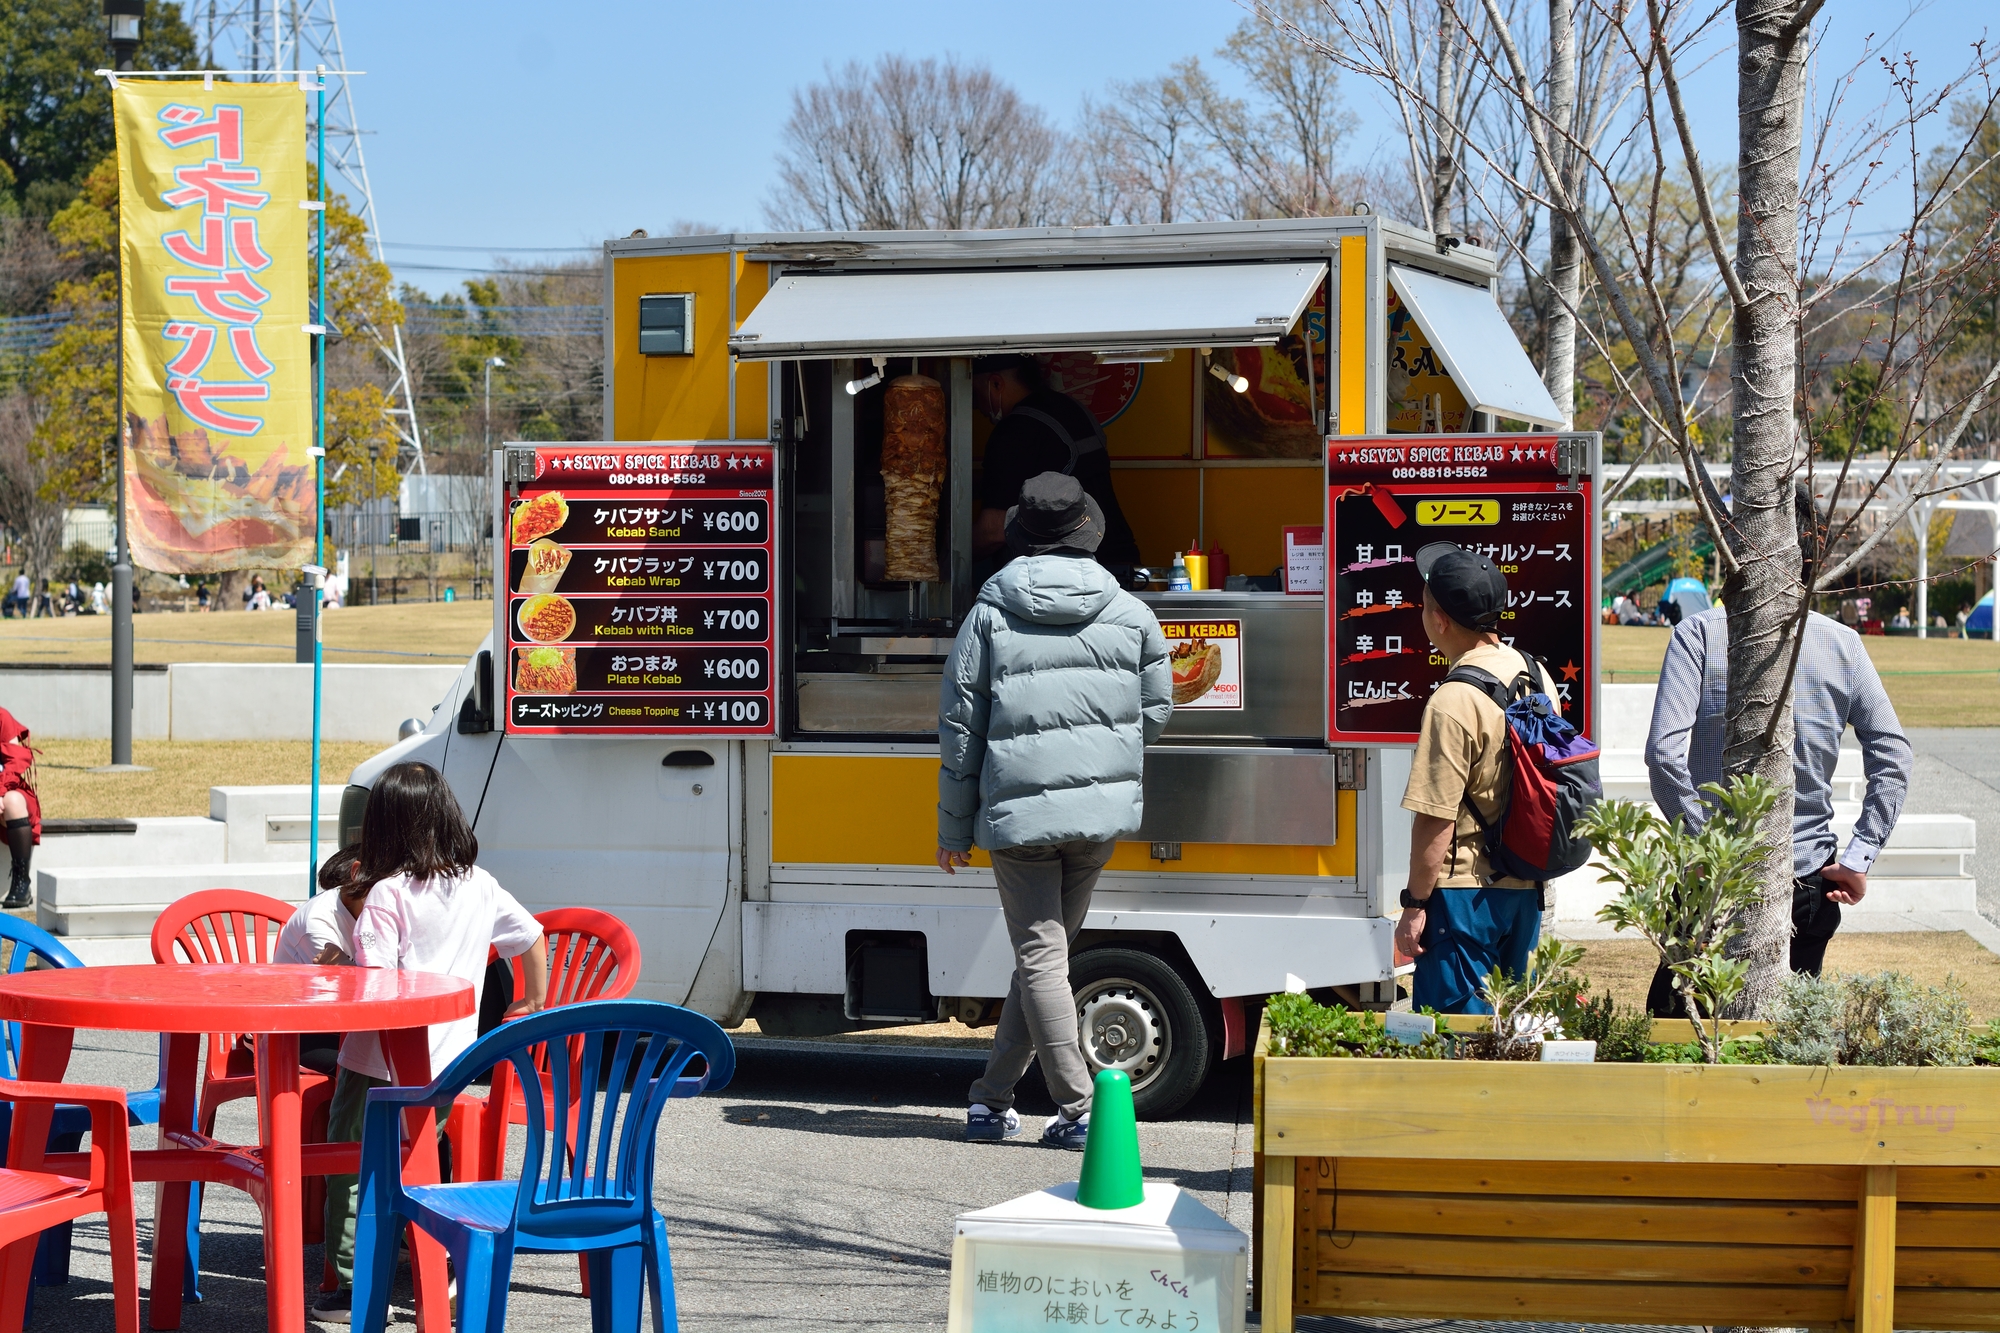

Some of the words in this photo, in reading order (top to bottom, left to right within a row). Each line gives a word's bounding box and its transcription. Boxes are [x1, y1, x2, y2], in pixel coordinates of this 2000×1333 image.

[573, 454, 621, 470] SEVEN
[625, 454, 666, 470] SPICE
[669, 453, 720, 470] KEBAB
[1360, 447, 1405, 464] SEVEN
[1409, 446, 1451, 463] SPICE
[1453, 445, 1504, 462] KEBAB
[1430, 504, 1486, 522] ソース
[1512, 502, 1574, 512] お好きなソースを
[593, 508, 695, 525] ケバブサンド
[702, 511, 760, 532] ¥600
[1512, 512, 1566, 521] お選びください
[606, 527, 646, 538] Kebab
[649, 527, 681, 538] Sand
[593, 557, 695, 574] ケバブラップ
[702, 560, 760, 581] ¥700
[606, 576, 646, 587] Kebab
[649, 576, 681, 588] Wrap
[610, 606, 678, 623] ケバブ丼
[703, 610, 760, 630] ¥700
[594, 625, 634, 636] Kebab
[636, 625, 664, 636] with
[666, 625, 694, 636] Rice
[1190, 624, 1237, 637] KEBAB
[611, 655, 678, 672] おつまみ
[703, 658, 760, 679] ¥600
[607, 674, 640, 684] Plate
[643, 674, 682, 684] Kebab
[1213, 684, 1237, 693] ¥600
[1349, 681, 1412, 699] にんにく
[518, 703, 604, 718] チーズトッピング
[608, 706, 642, 716] Cheese
[643, 706, 680, 718] Topping
[976, 1269, 1134, 1301] 植物のにおいを
[1150, 1269, 1189, 1299] くんくん
[1043, 1300, 1200, 1332] 体験してみよう
